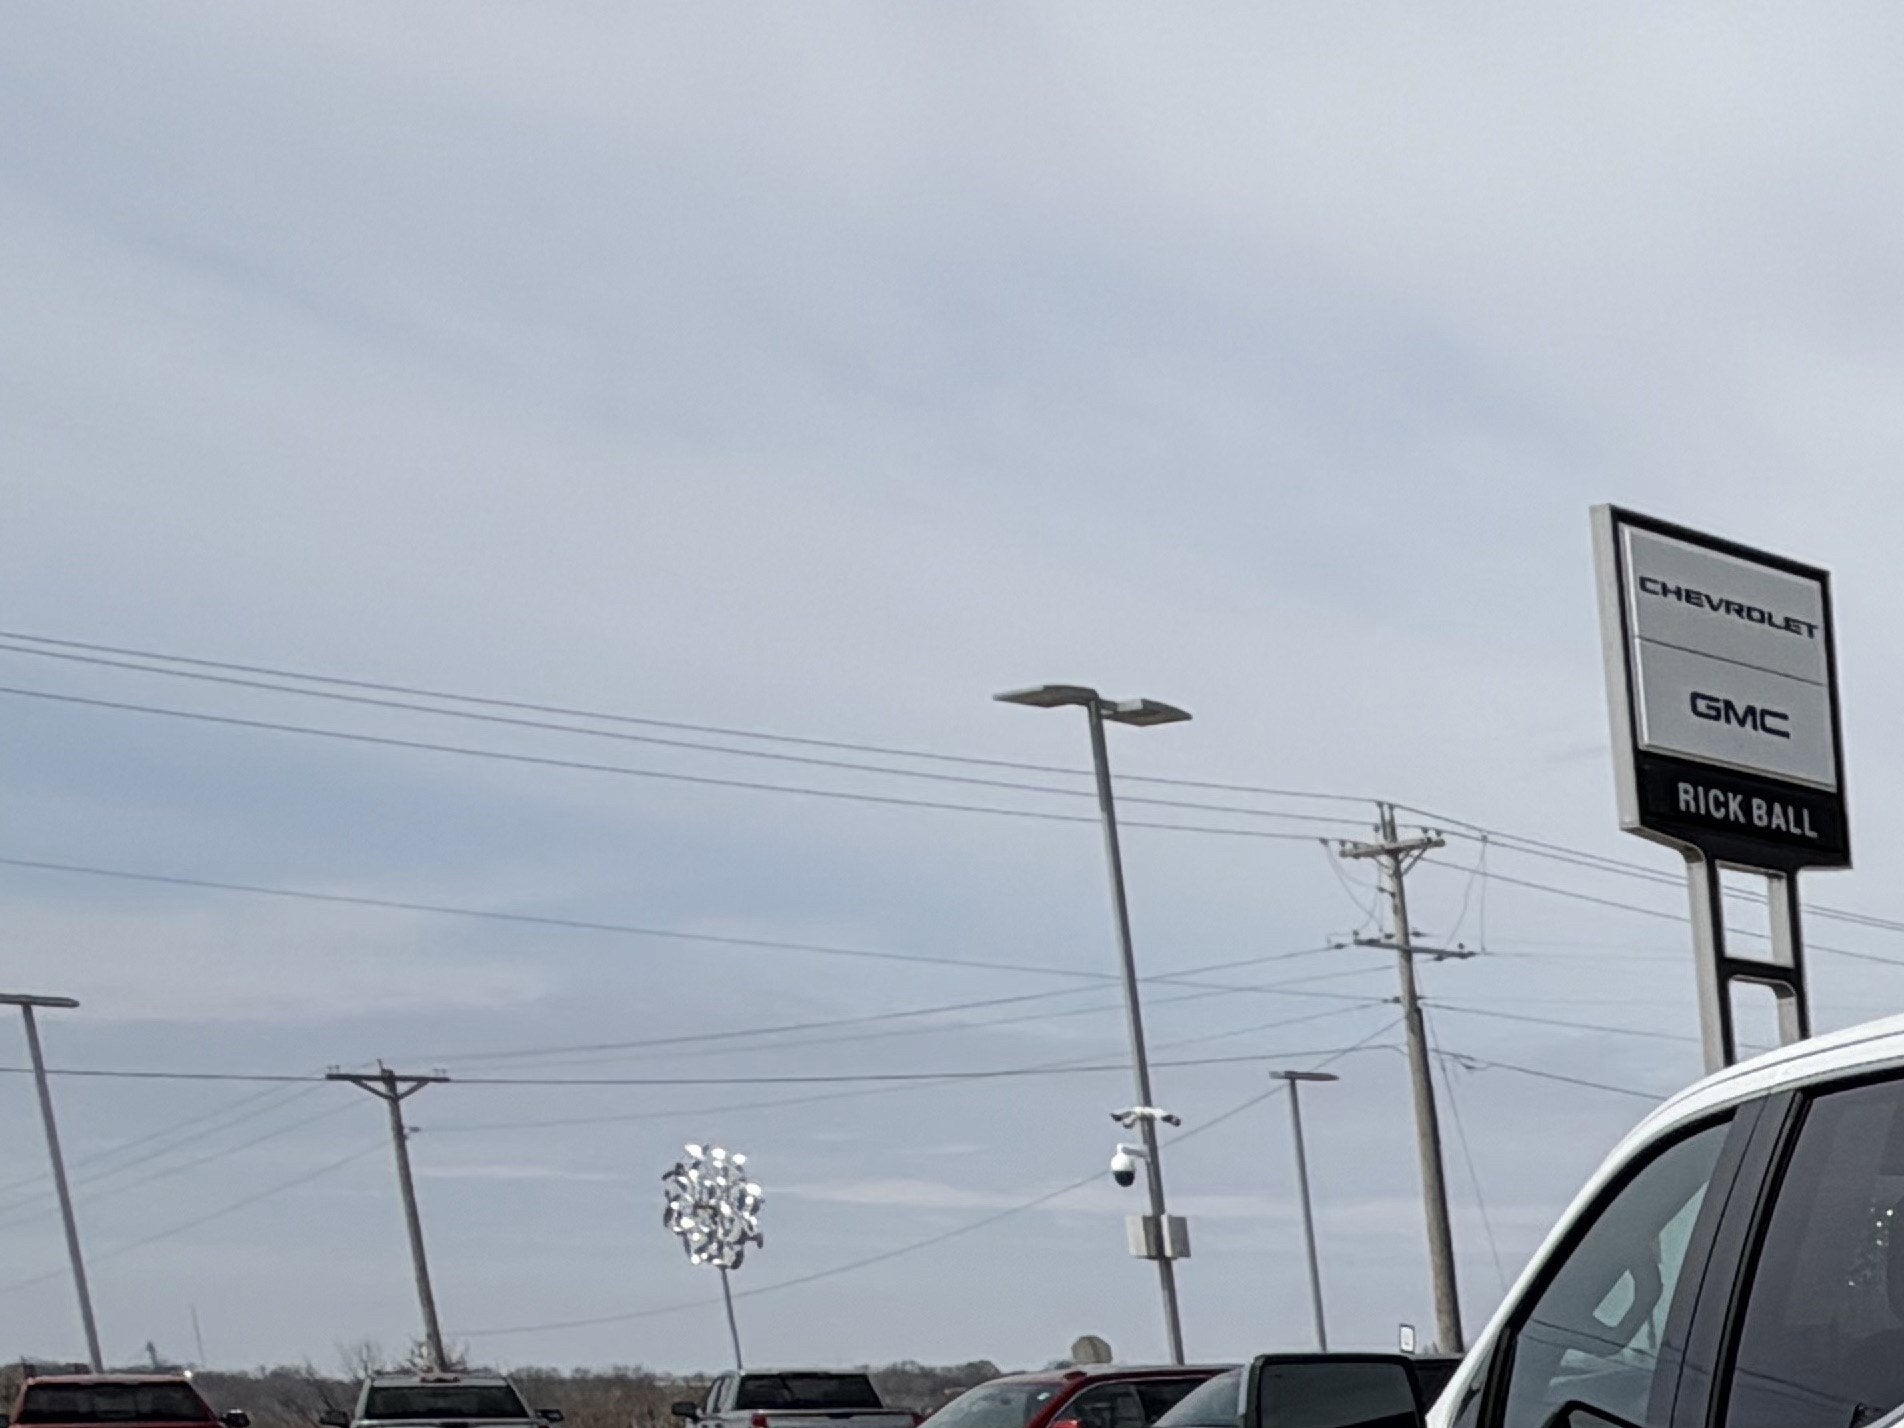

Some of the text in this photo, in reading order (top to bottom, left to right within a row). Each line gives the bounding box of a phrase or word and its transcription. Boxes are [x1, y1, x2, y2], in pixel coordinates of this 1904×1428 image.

[1639, 575, 1818, 639] CHEVROLET
[1690, 691, 1791, 740] GMC
[1678, 782, 1818, 839] RICK BALL
